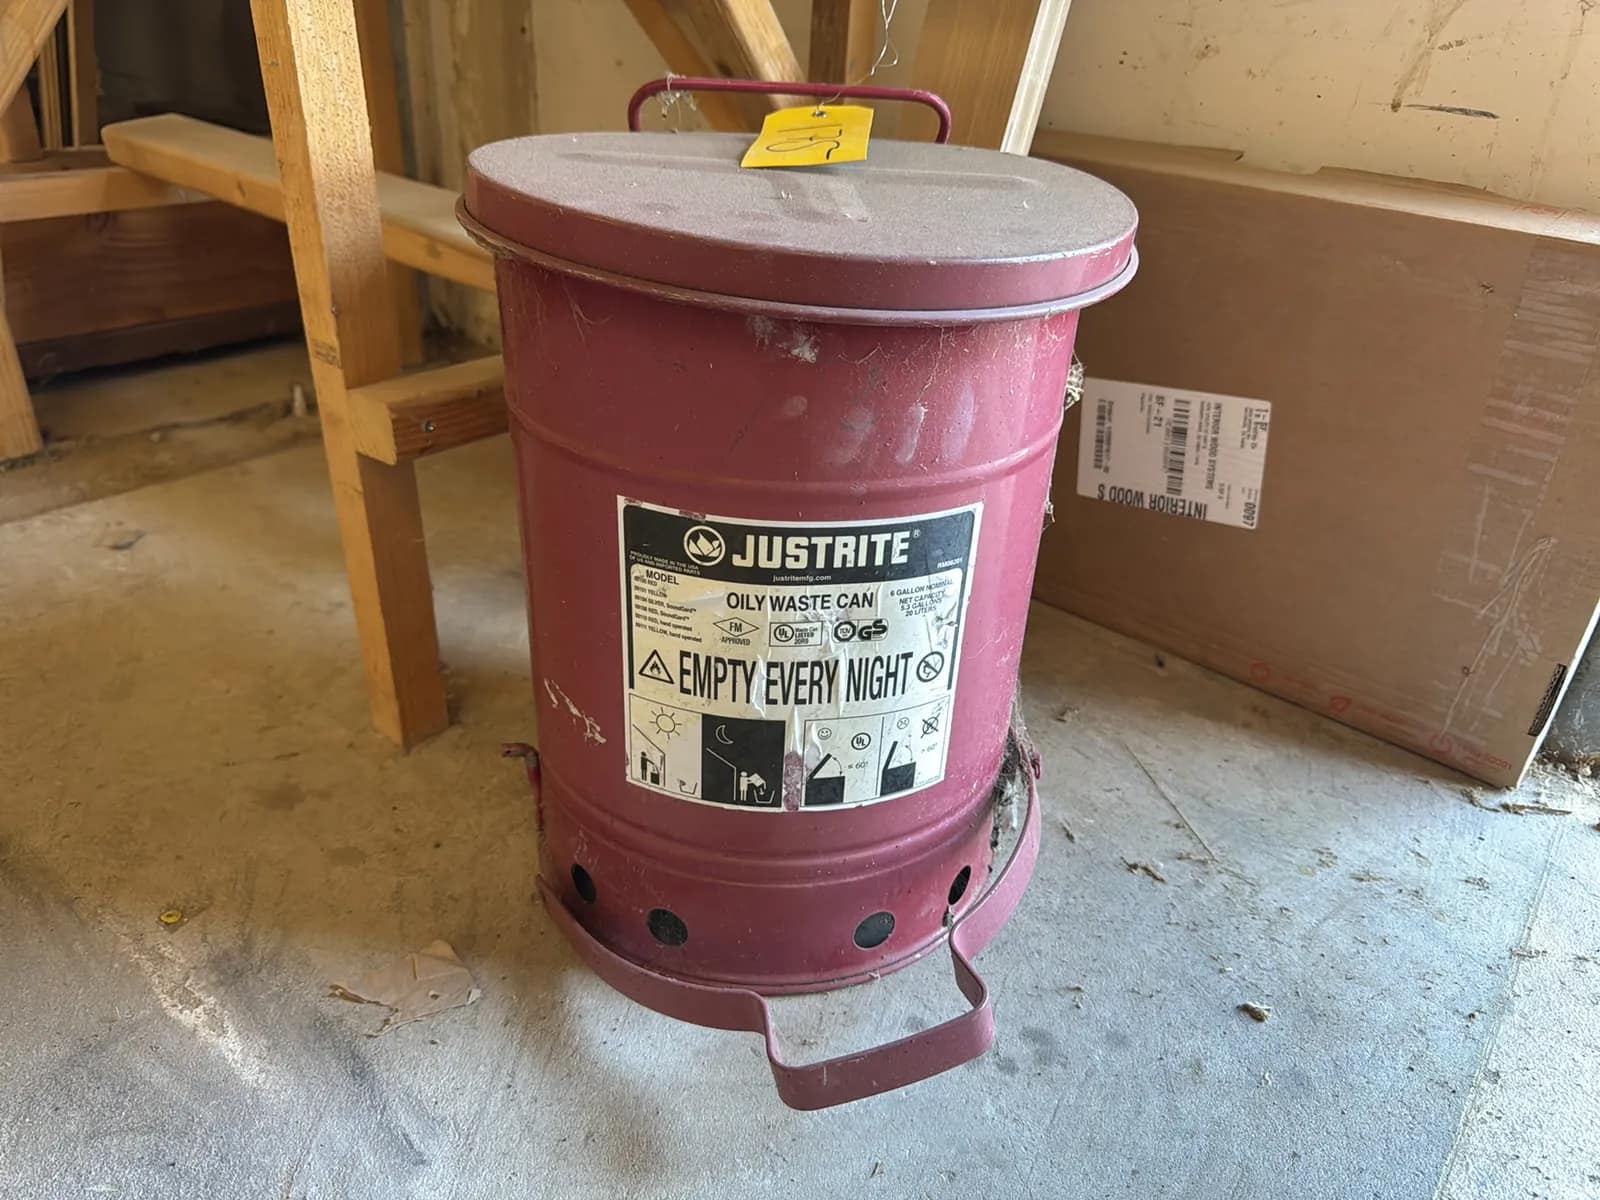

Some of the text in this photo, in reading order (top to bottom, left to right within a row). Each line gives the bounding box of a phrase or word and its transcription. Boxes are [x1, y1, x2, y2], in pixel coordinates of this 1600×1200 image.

[1097, 483, 1106, 499] S
[1109, 485, 1148, 508] WOOD
[1150, 494, 1208, 520] INTERIOR
[646, 569, 680, 586] MODEL
[773, 575, 832, 584] justritemfg.com
[896, 585, 926, 597] GALLON
[899, 590, 945, 606] NET CAPACITY
[727, 592, 874, 612] OILY WASTE CAN
[729, 621, 743, 632] FM
[858, 619, 888, 640] GS
[721, 636, 751, 646] APPROVED
[679, 650, 914, 706] EMPTY EVERY NIGHT
